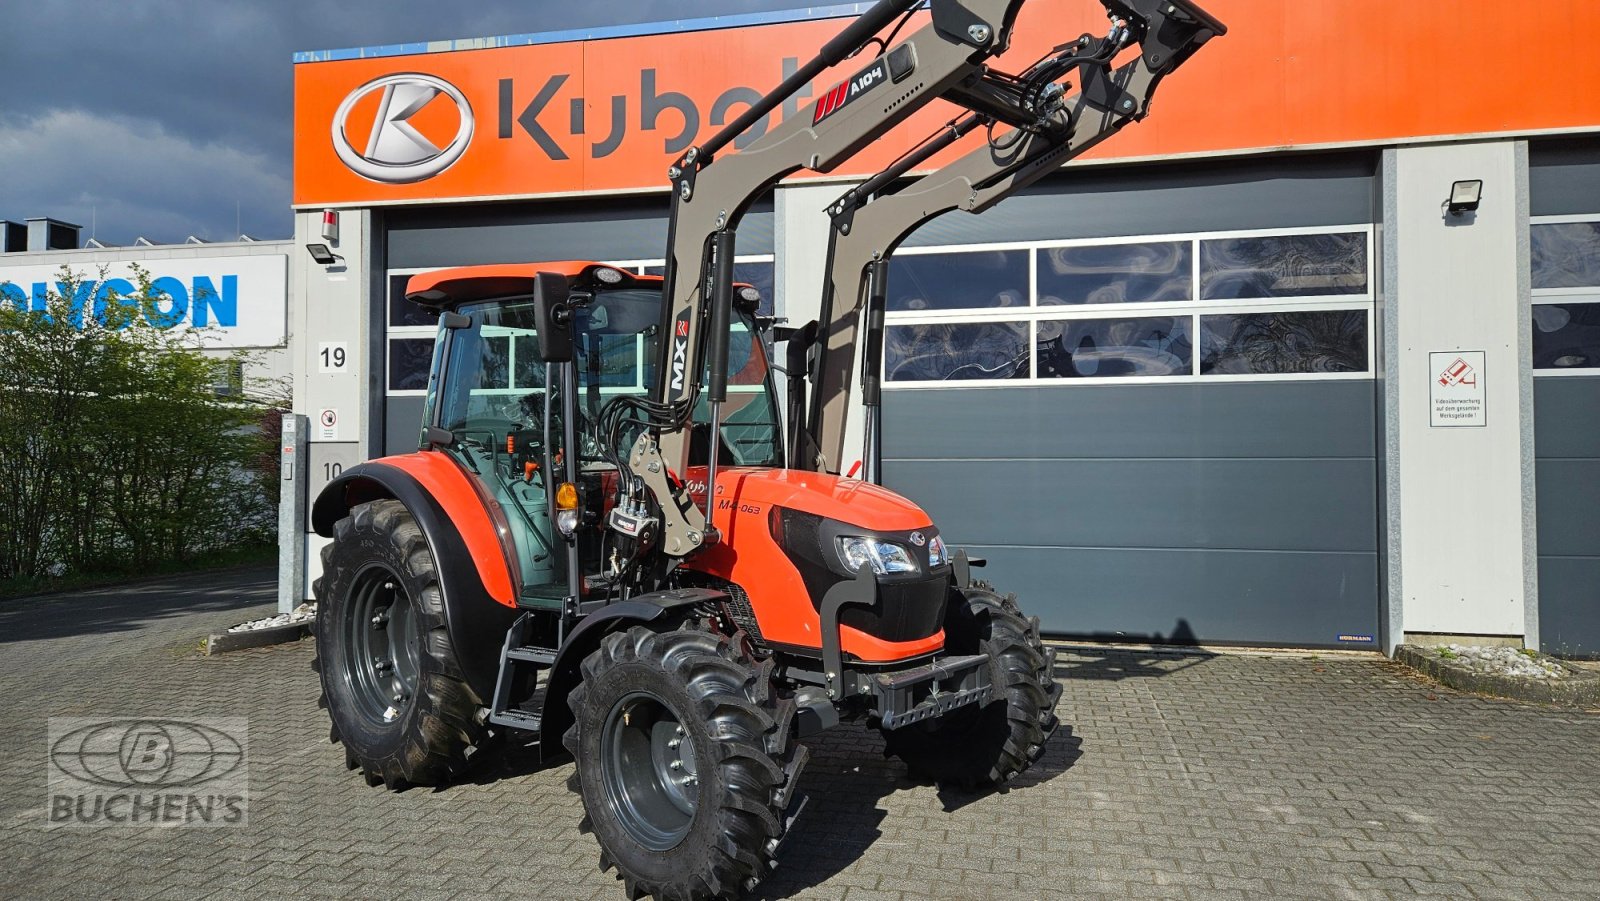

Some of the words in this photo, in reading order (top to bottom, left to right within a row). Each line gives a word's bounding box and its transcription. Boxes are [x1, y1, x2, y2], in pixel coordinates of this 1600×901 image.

[851, 66, 883, 96] A104
[498, 57, 813, 161] Kubot
[320, 346, 347, 368] 19
[670, 338, 687, 391] MX
[323, 462, 342, 481] 10
[719, 499, 761, 515] M4-063
